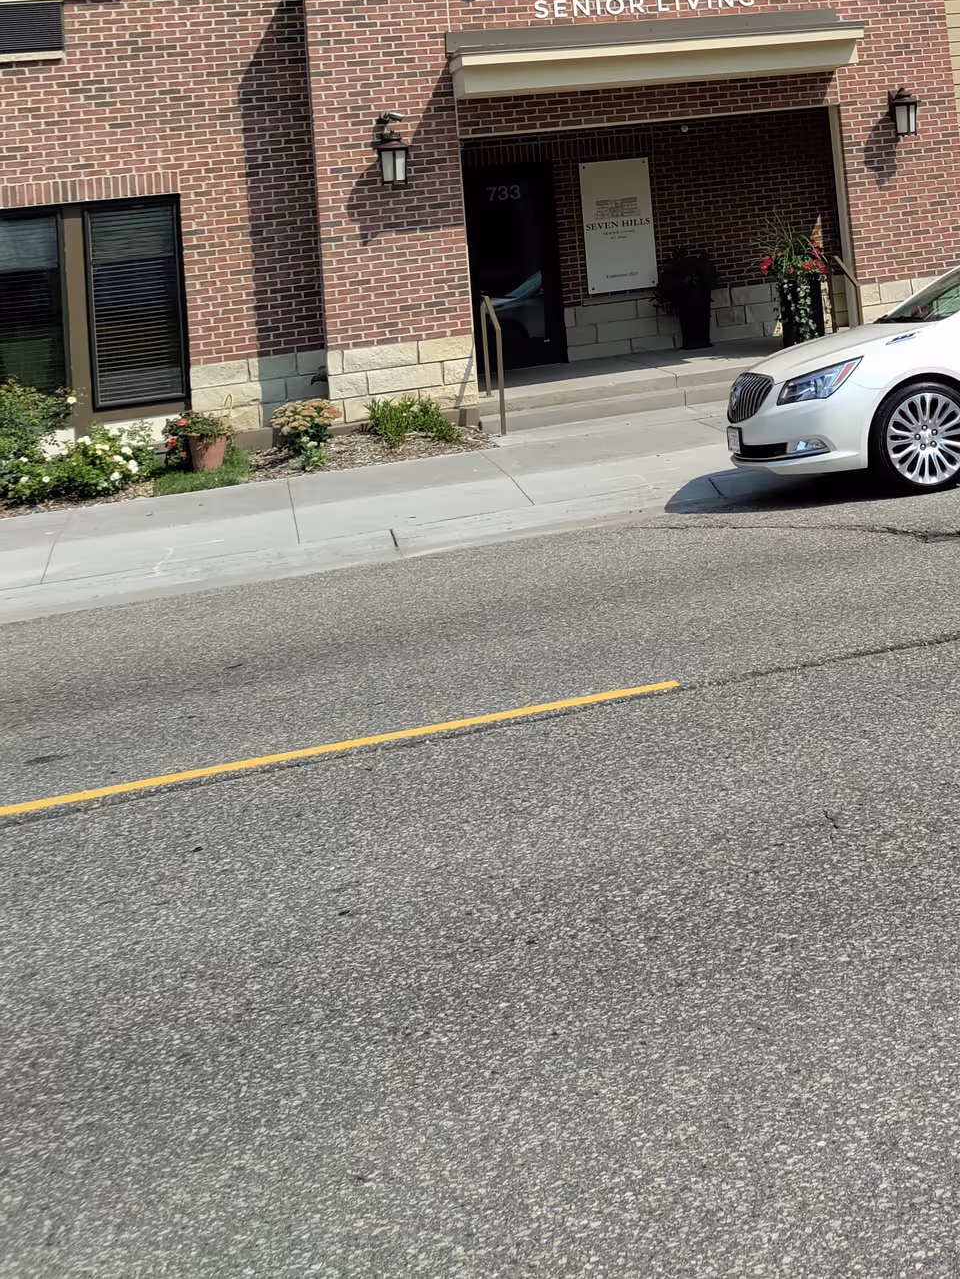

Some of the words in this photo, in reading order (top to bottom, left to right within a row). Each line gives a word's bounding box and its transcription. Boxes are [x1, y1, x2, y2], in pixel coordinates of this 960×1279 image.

[486, 183, 522, 202] 733
[586, 220, 619, 232] SEVEN
[621, 217, 651, 228] HILLS
